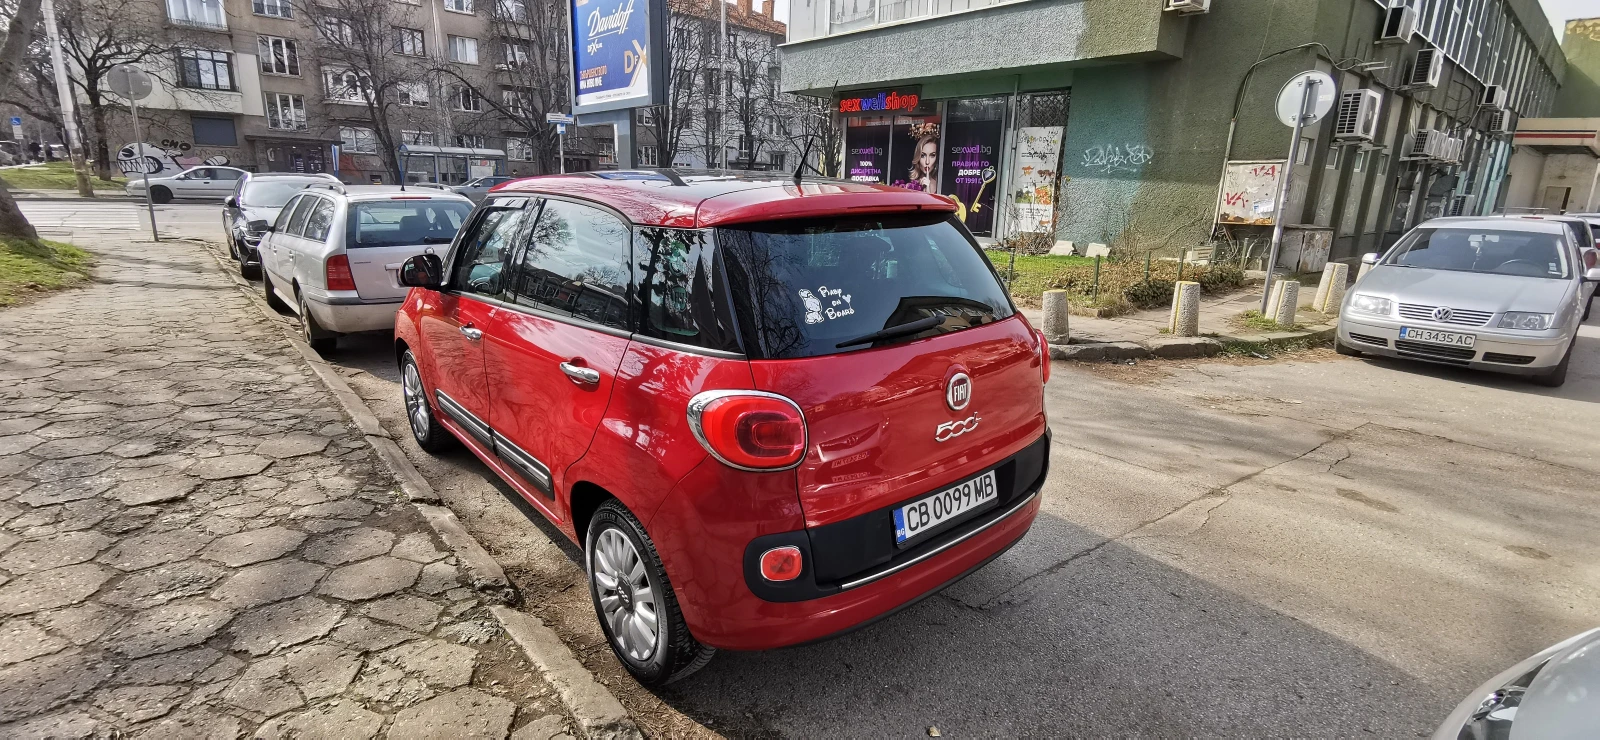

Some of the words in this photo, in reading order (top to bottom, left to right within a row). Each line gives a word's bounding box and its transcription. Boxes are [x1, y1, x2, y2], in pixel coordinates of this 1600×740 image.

[587, 0, 634, 36] Davidoff
[840, 91, 918, 112] sexwellshop
[1407, 329, 1424, 339] CH
[1424, 331, 1454, 343] 3435
[1456, 335, 1473, 345] AC
[953, 383, 967, 402] FIAT
[907, 501, 930, 532] CB
[933, 484, 971, 520] 0099
[973, 474, 994, 502] MB
[897, 528, 905, 537] BG
